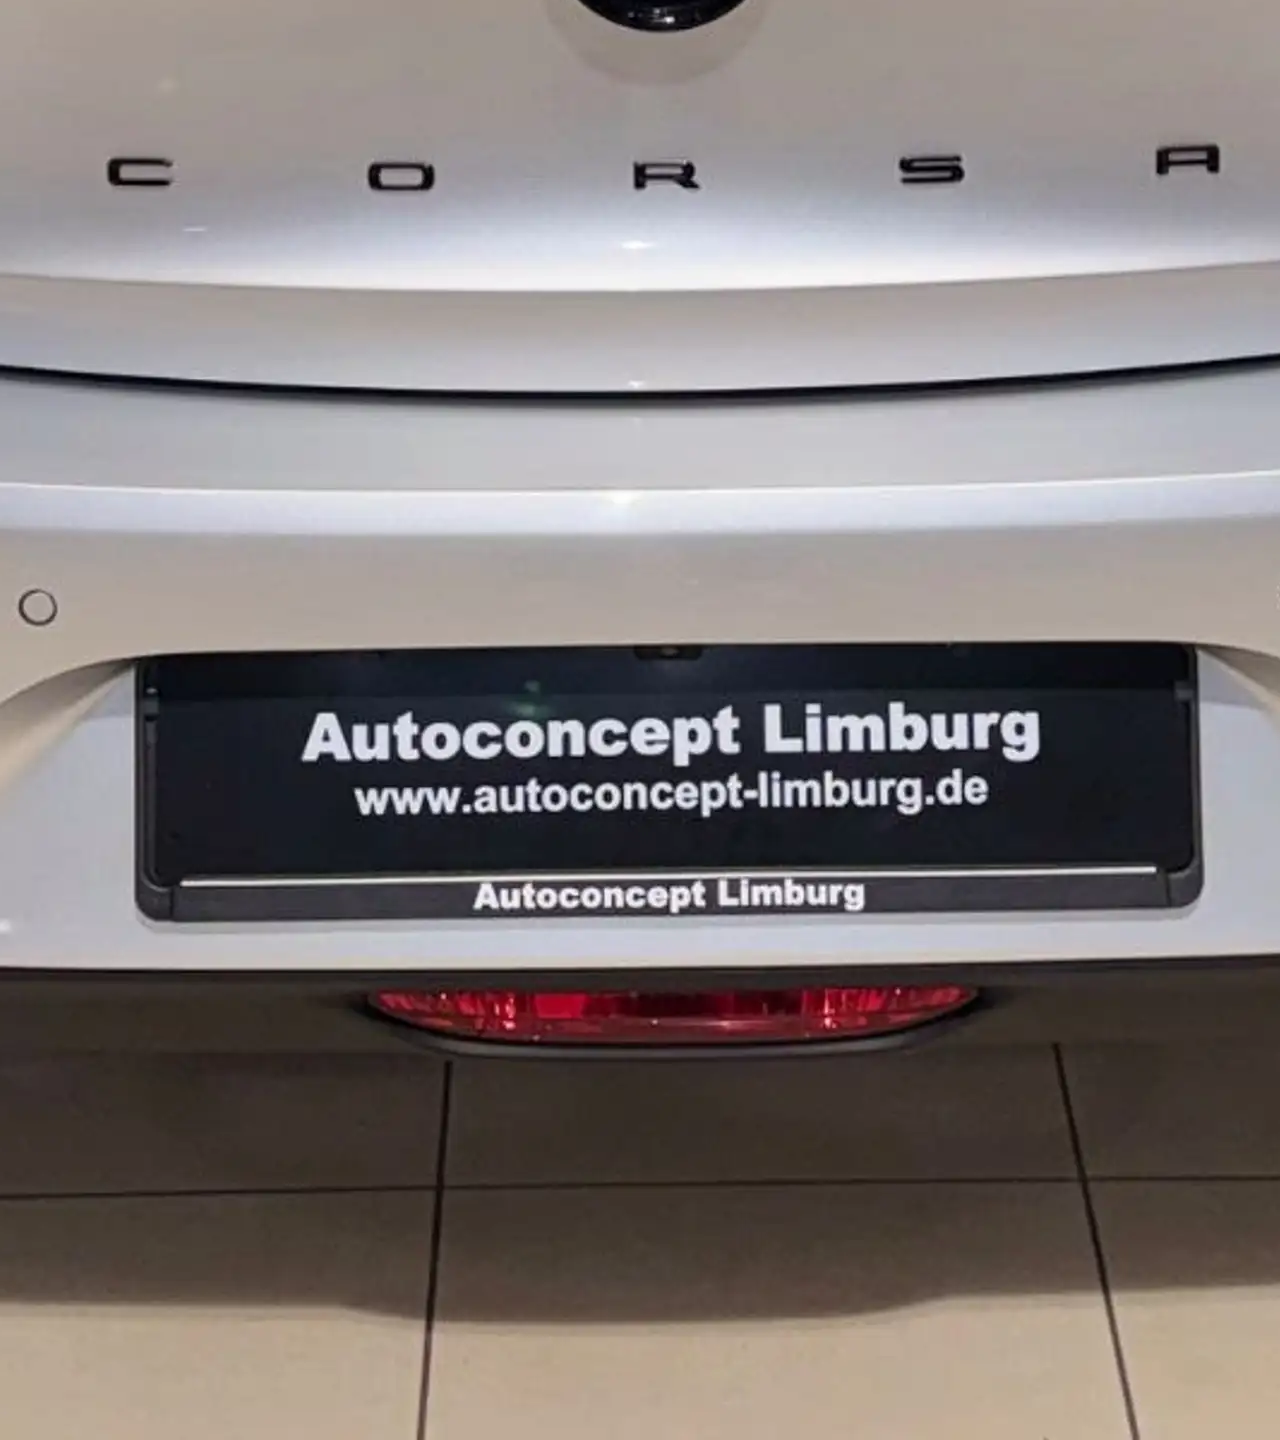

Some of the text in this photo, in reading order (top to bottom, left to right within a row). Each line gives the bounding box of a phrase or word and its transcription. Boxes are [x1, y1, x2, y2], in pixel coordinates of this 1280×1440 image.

[107, 144, 1220, 191] CORSA
[301, 702, 1041, 767] Autoconcept Limburg
[354, 769, 989, 817] www.autoconcept-limburg.de
[473, 877, 867, 913] Autoconcept Limburg
